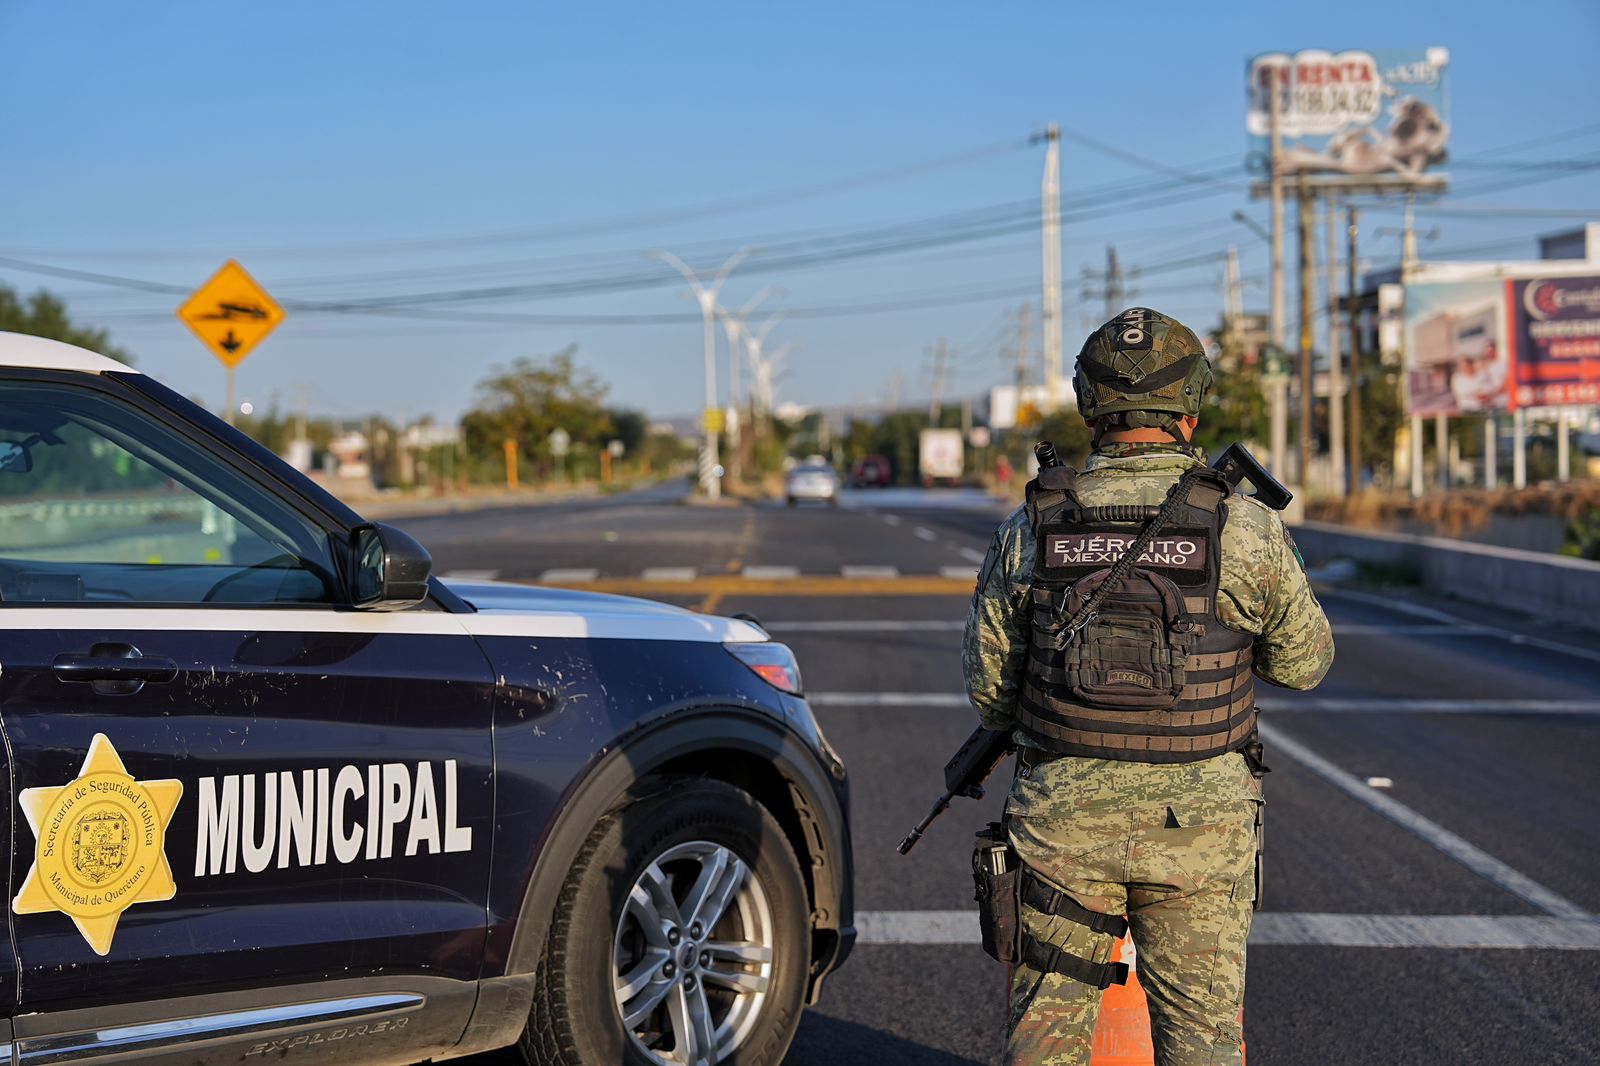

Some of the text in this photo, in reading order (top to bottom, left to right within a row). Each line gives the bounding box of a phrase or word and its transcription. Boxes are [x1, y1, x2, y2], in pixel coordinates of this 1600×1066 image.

[1296, 62, 1373, 85] RENTA
[43, 780, 156, 857] Secretaría de Seguridad Pública
[195, 759, 472, 877] MUNICIPAL
[49, 865, 146, 906] Municipal de Querétaro
[245, 1018, 409, 1056] EXPLORER
